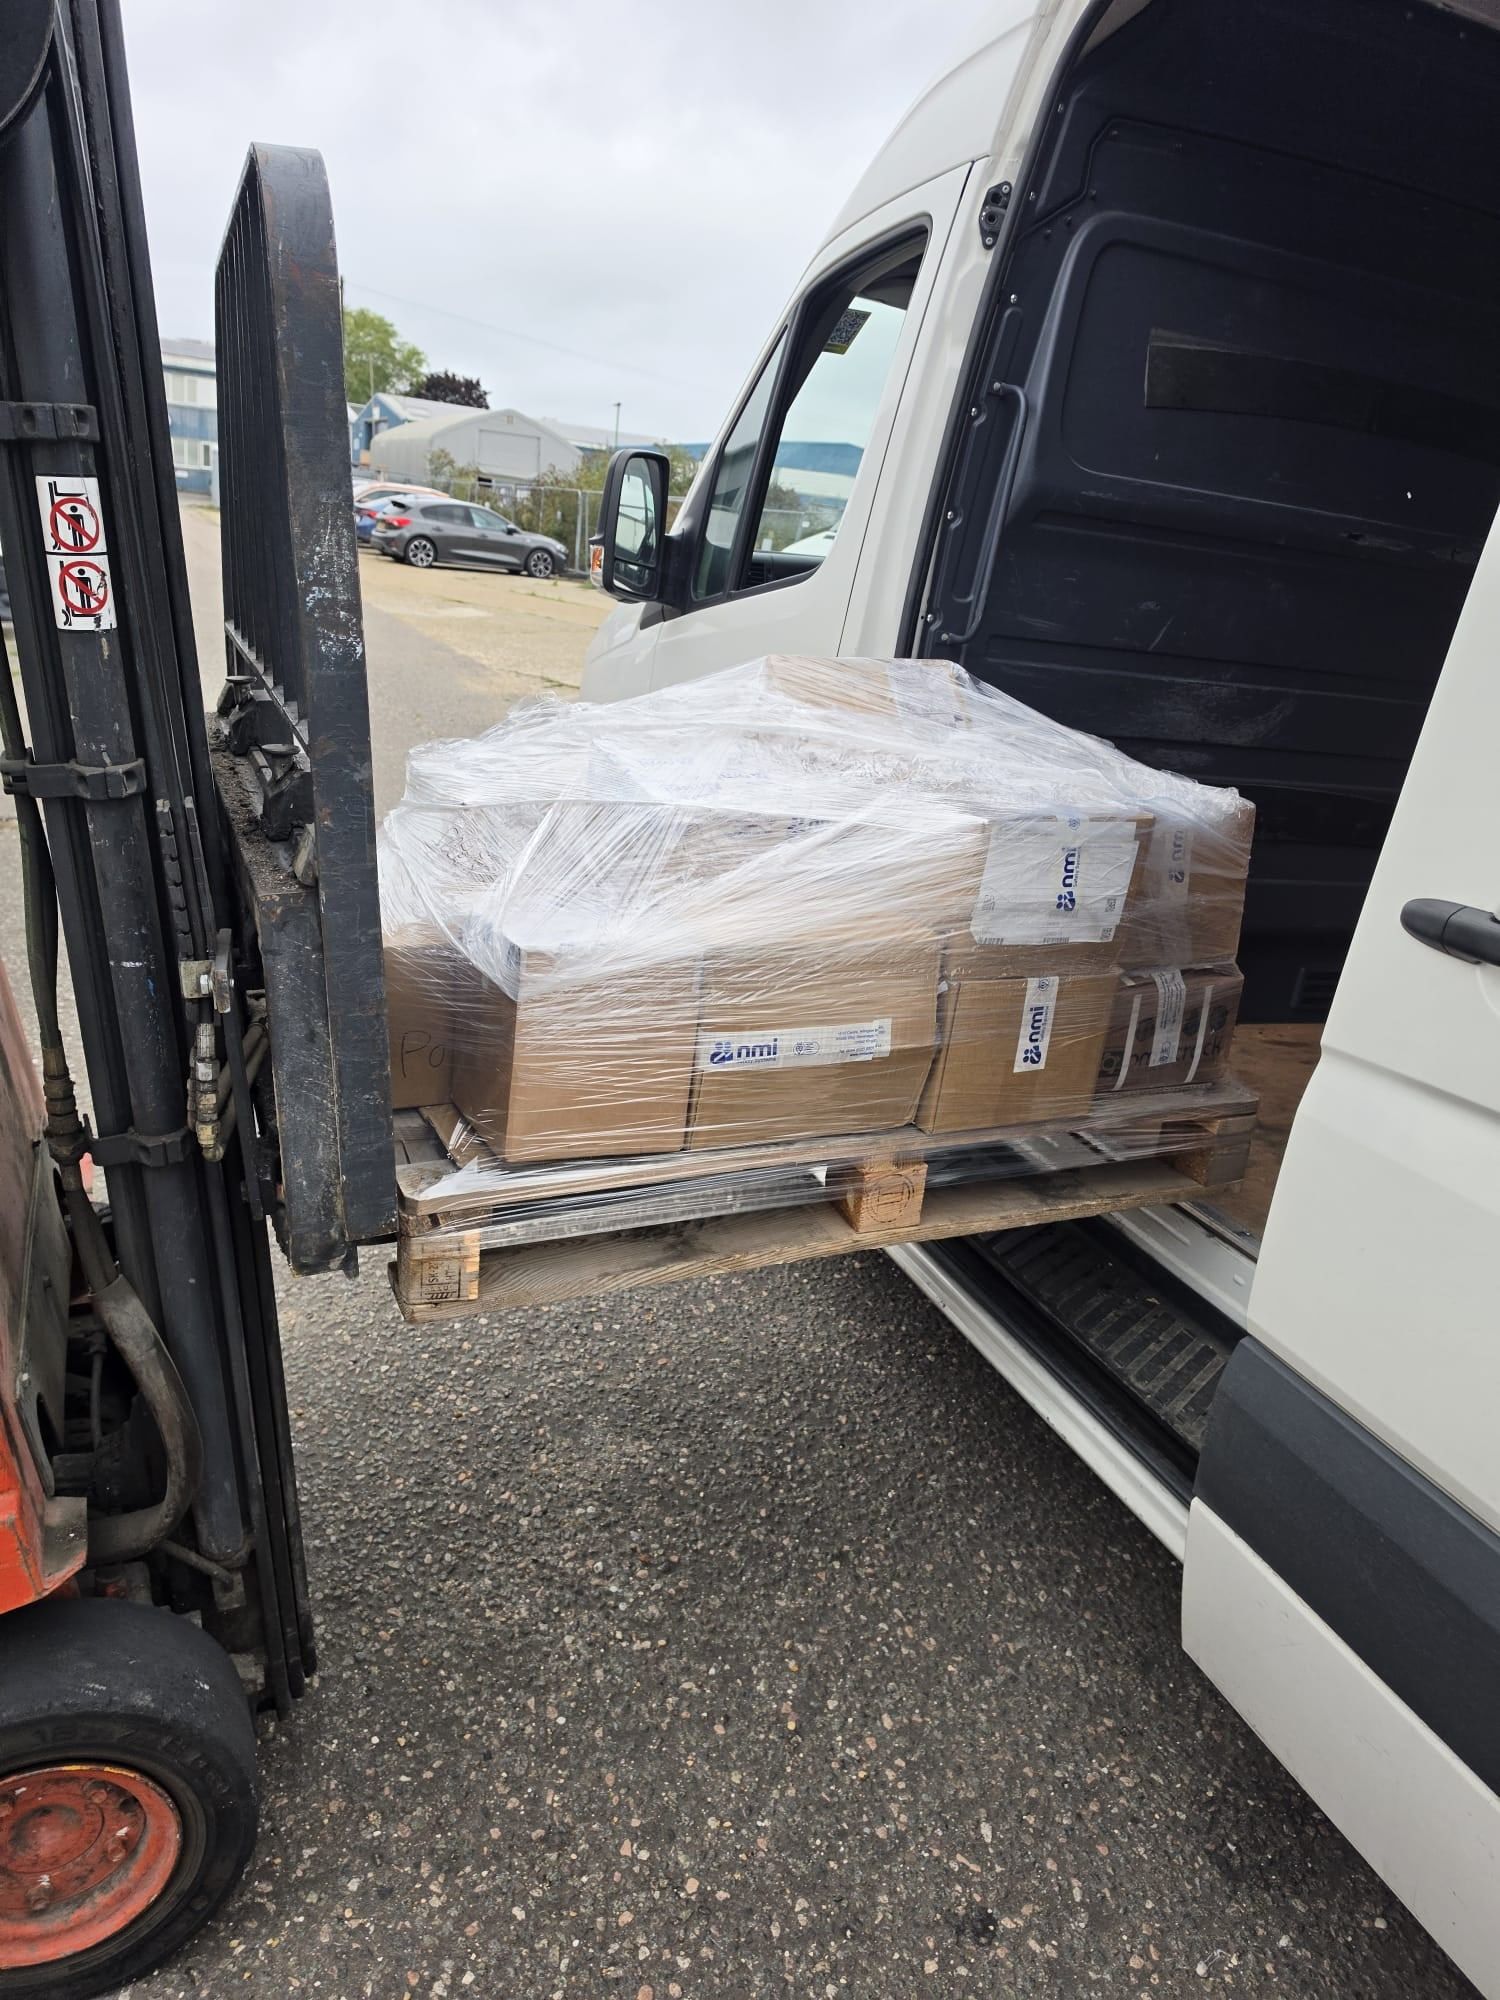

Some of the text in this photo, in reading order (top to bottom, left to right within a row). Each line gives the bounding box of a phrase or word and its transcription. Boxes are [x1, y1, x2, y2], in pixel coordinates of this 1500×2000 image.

[1171, 830, 1185, 862] nm
[1061, 847, 1077, 888] nmi
[1028, 1006, 1044, 1043] nmi
[737, 1038, 778, 1058] nmi
